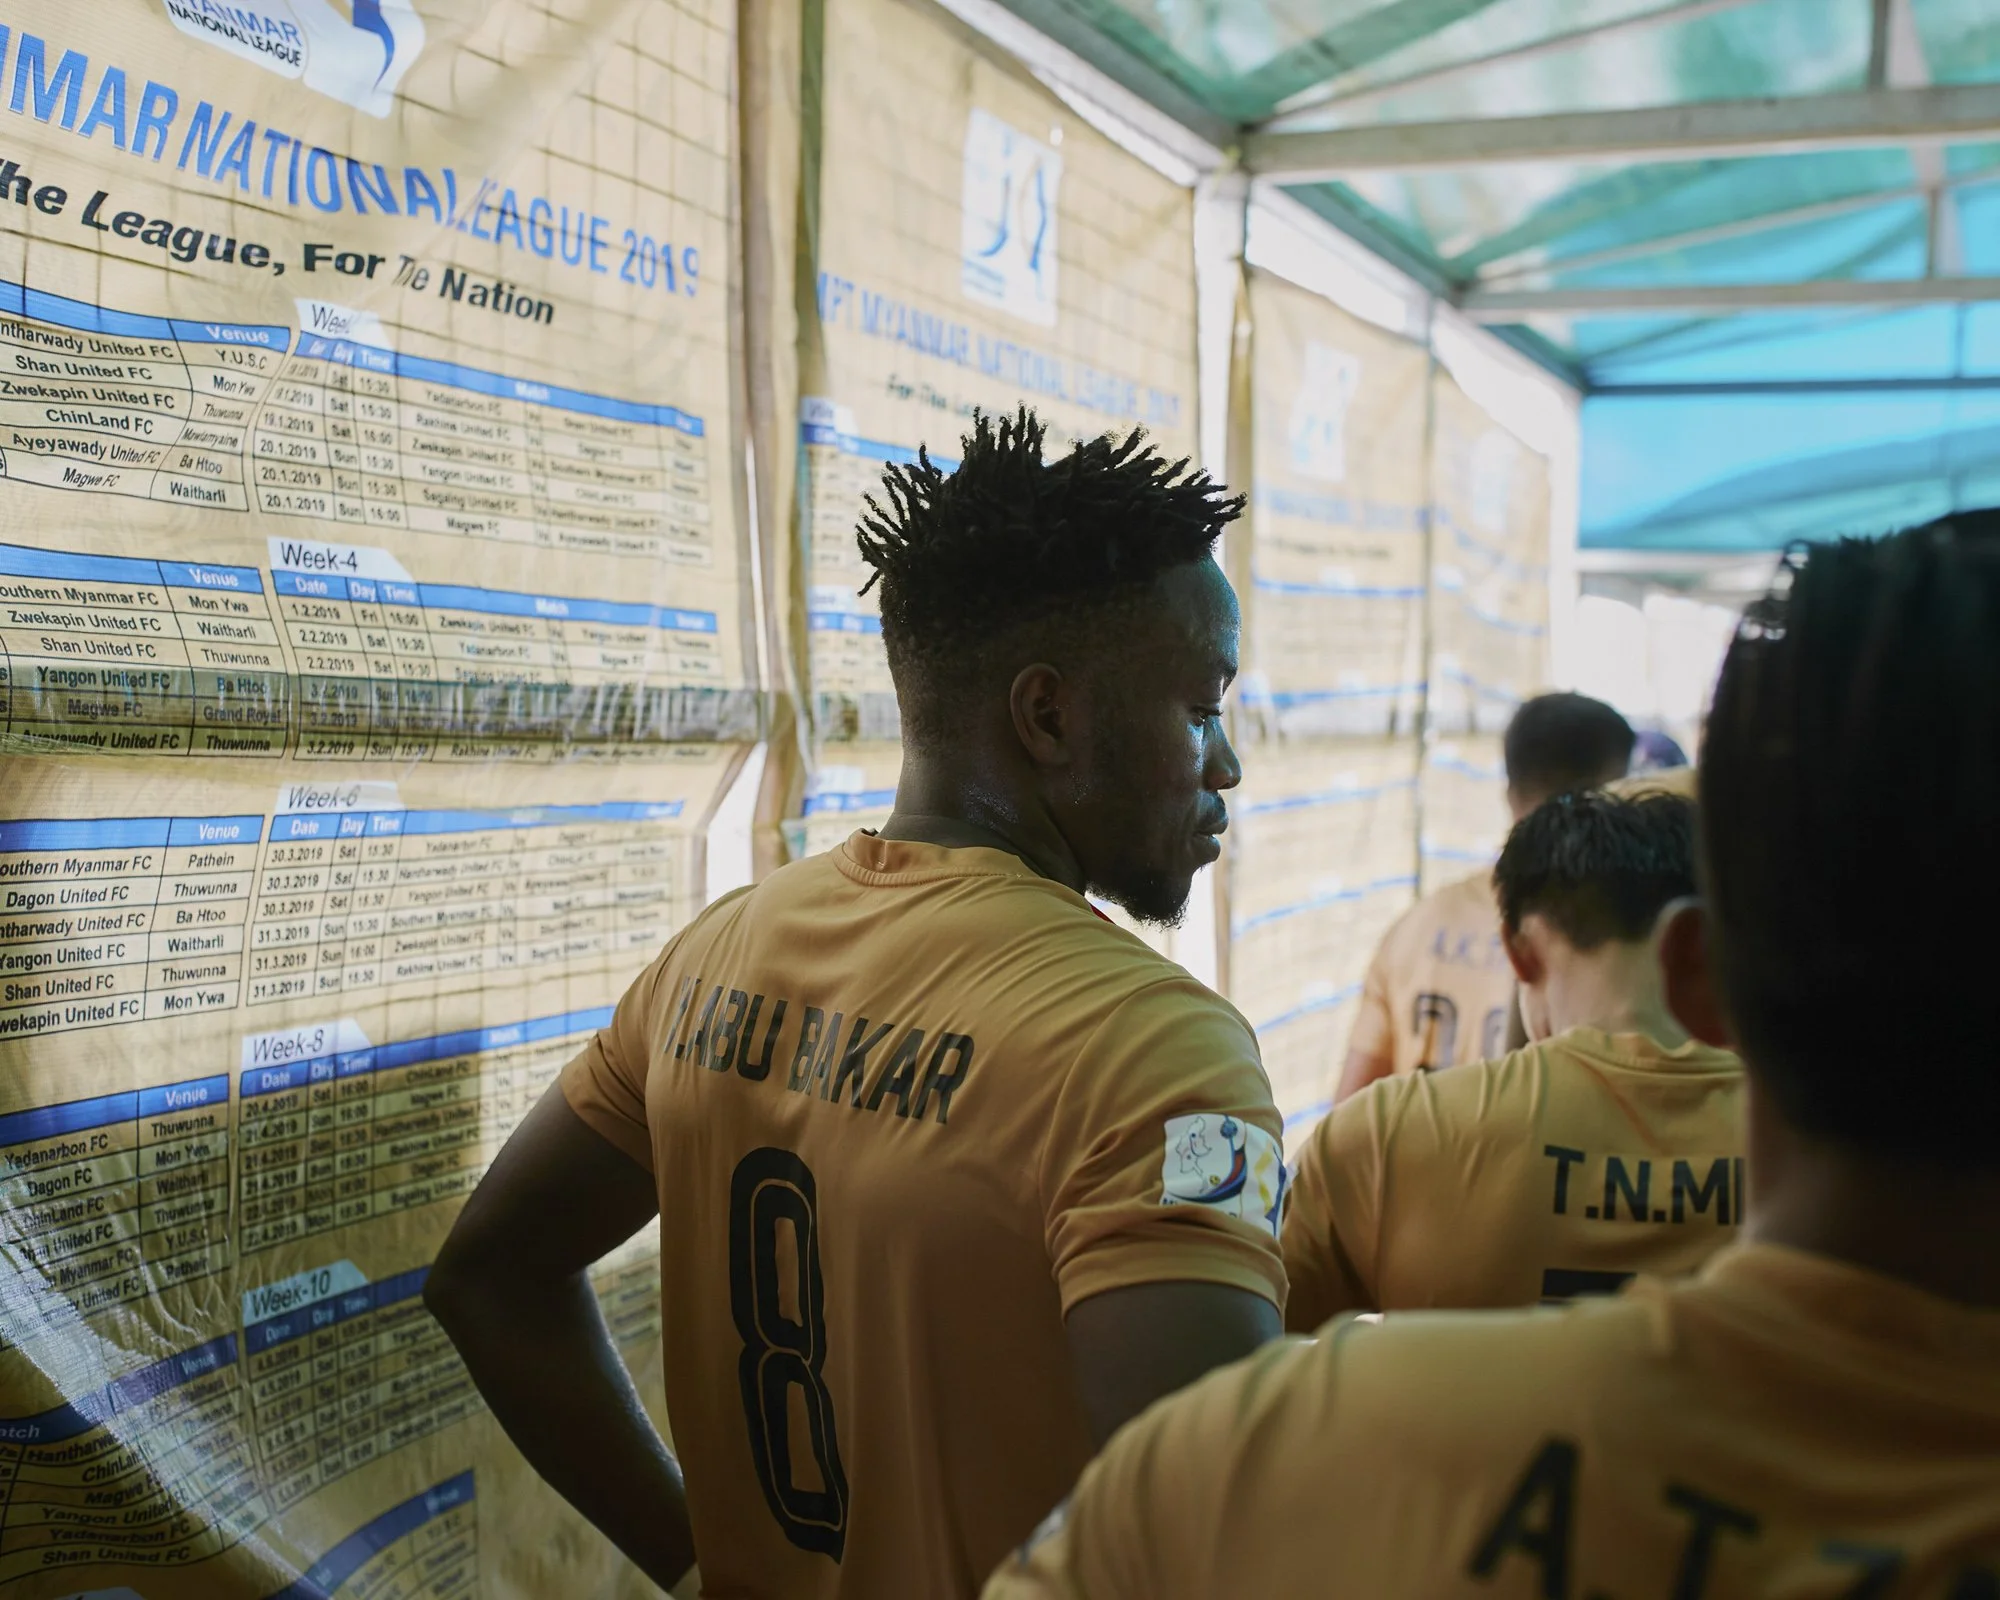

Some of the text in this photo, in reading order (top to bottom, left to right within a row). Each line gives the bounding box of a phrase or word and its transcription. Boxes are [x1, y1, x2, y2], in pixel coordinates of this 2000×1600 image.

[168, 2, 302, 67] NATIONAL LEAGUE
[0, 23, 180, 163] MAR
[619, 228, 699, 298] 2019
[0, 158, 68, 216] he
[81, 190, 286, 277] League,
[303, 243, 386, 279] For
[439, 268, 554, 328] Nation
[205, 324, 270, 344] Venue
[89, 337, 145, 357] United
[151, 345, 174, 359] FC
[15, 355, 152, 380] Shan United FC
[217, 348, 267, 370] Y.U.S.C
[213, 375, 236, 392] Mon
[1, 380, 175, 409] Zwekapin United FC
[203, 402, 244, 421] Thuwunna
[46, 409, 154, 435] ChinLand FC
[13, 432, 160, 465] Ayeyawady United FC
[260, 438, 317, 461] 20.1.2019
[179, 453, 222, 474] Ba Htoo
[62, 467, 119, 489] Magwe FC
[262, 466, 322, 487] 20.1.2019
[170, 481, 226, 504] Waitharli
[265, 494, 325, 513] 20.1.2019
[281, 541, 358, 573] Week-4
[188, 568, 239, 587] Venue
[295, 577, 328, 594] Date
[0, 585, 159, 606] outhern Myanmar FC
[351, 582, 376, 602] Day
[383, 585, 415, 601] Time
[188, 595, 249, 613] Mon Ywa
[292, 603, 341, 620] 1.2.2019
[8, 610, 161, 632] Zwekapin United FC
[361, 609, 378, 623] Fri
[197, 621, 256, 640] Waitharli
[299, 629, 348, 646] 2.2.2019
[40, 637, 157, 659] Shan United FC
[200, 649, 270, 667] Thuwunna
[307, 656, 355, 672] 2.2.2019
[38, 666, 170, 690] Yangon United FC
[217, 676, 234, 692] Ba
[68, 698, 143, 719] Magwe FC
[203, 706, 281, 725] Grand Royal
[111, 734, 180, 749] United FC
[206, 735, 270, 751] Thuwunna
[307, 741, 354, 755] 3.2.2019
[288, 785, 361, 810] Week-6
[199, 824, 240, 840] Venue
[291, 819, 319, 835] Date
[341, 819, 365, 836] Day
[372, 815, 399, 832] Time
[188, 852, 235, 869] Pathein
[272, 847, 323, 863] 30.3.2019
[0, 855, 152, 877] outhern Myanmar FC
[175, 881, 238, 897] Thuwunna
[267, 874, 319, 890] 30.3.2019
[6, 885, 130, 911] Dagon United FC
[262, 900, 314, 916] 30.3.2019
[77, 916, 123, 932] United
[127, 913, 146, 928] FC
[176, 909, 226, 924] Ba Htoo
[168, 934, 224, 953] Waitharli
[258, 926, 310, 943] 31.3.2019
[0, 943, 126, 972] Yangon United FC
[256, 952, 307, 971] 31.3.2019
[162, 963, 226, 982] Thuwunna
[5, 973, 114, 1002] Shan United FC
[254, 980, 305, 998] 31.3.2019
[65, 1005, 115, 1023] United
[120, 999, 139, 1015] FC
[164, 991, 225, 1011] Mon Ywa
[253, 1028, 324, 1063] Week-8
[788, 1006, 975, 1125] BAKAR
[261, 1072, 290, 1089] Date
[165, 1086, 208, 1107] Venue
[152, 1114, 214, 1138] Thuwunna
[4, 1134, 109, 1169] Yadanarbon FC
[156, 1150, 182, 1166] Mon
[28, 1168, 92, 1197] Dagon FC
[87, 1196, 105, 1214] FC
[53, 1228, 94, 1251] United
[96, 1223, 114, 1240] FC
[60, 1248, 134, 1287] Myanmar FC
[83, 1284, 120, 1309] United
[123, 1276, 140, 1293] FC
[252, 1269, 330, 1318] Week-10
[729, 1147, 849, 1564] 8
[84, 1481, 144, 1505] Magwe
[42, 1499, 173, 1524] Yangon United
[50, 1518, 191, 1541] Yadanarbon FC
[42, 1548, 190, 1565] Shan United FC
